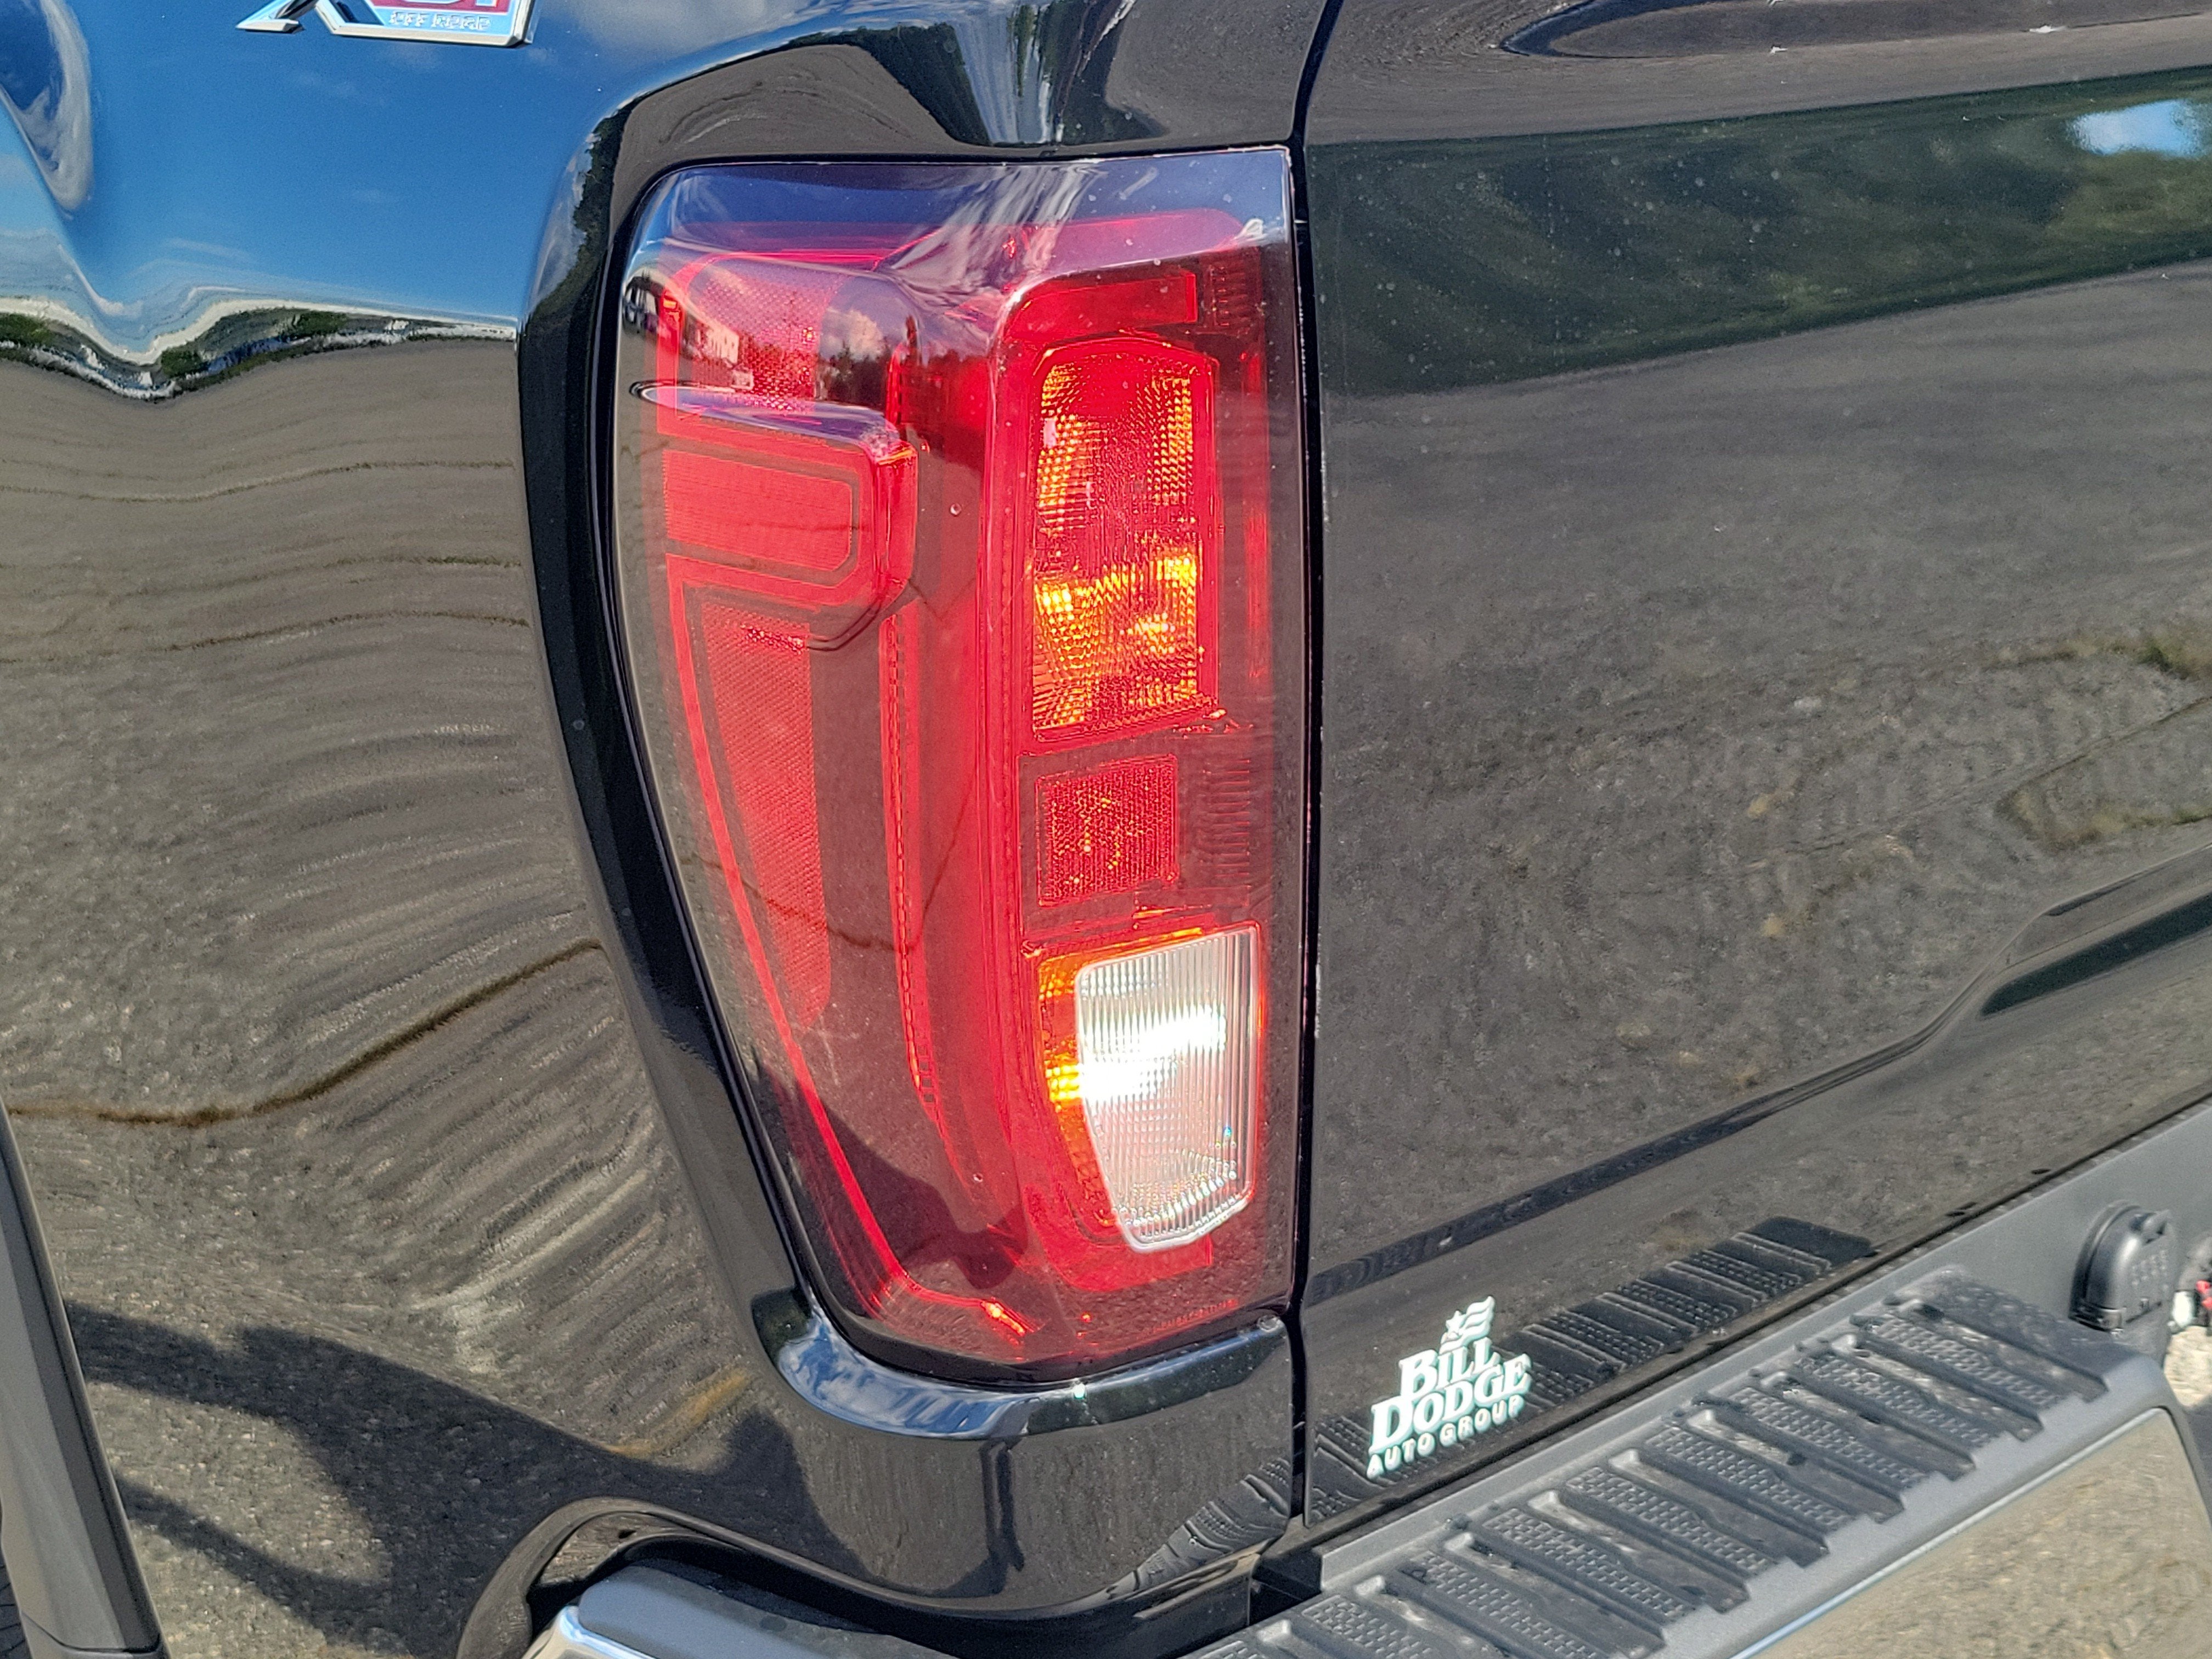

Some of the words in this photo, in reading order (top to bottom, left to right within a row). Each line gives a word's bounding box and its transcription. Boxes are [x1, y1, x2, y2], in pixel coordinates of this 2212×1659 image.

[1368, 1353, 1532, 1455] DODGE
[1399, 1336, 1502, 1400] BILL
[1367, 1432, 1435, 1479] AUTO
[1440, 1394, 1525, 1447] GROUP
